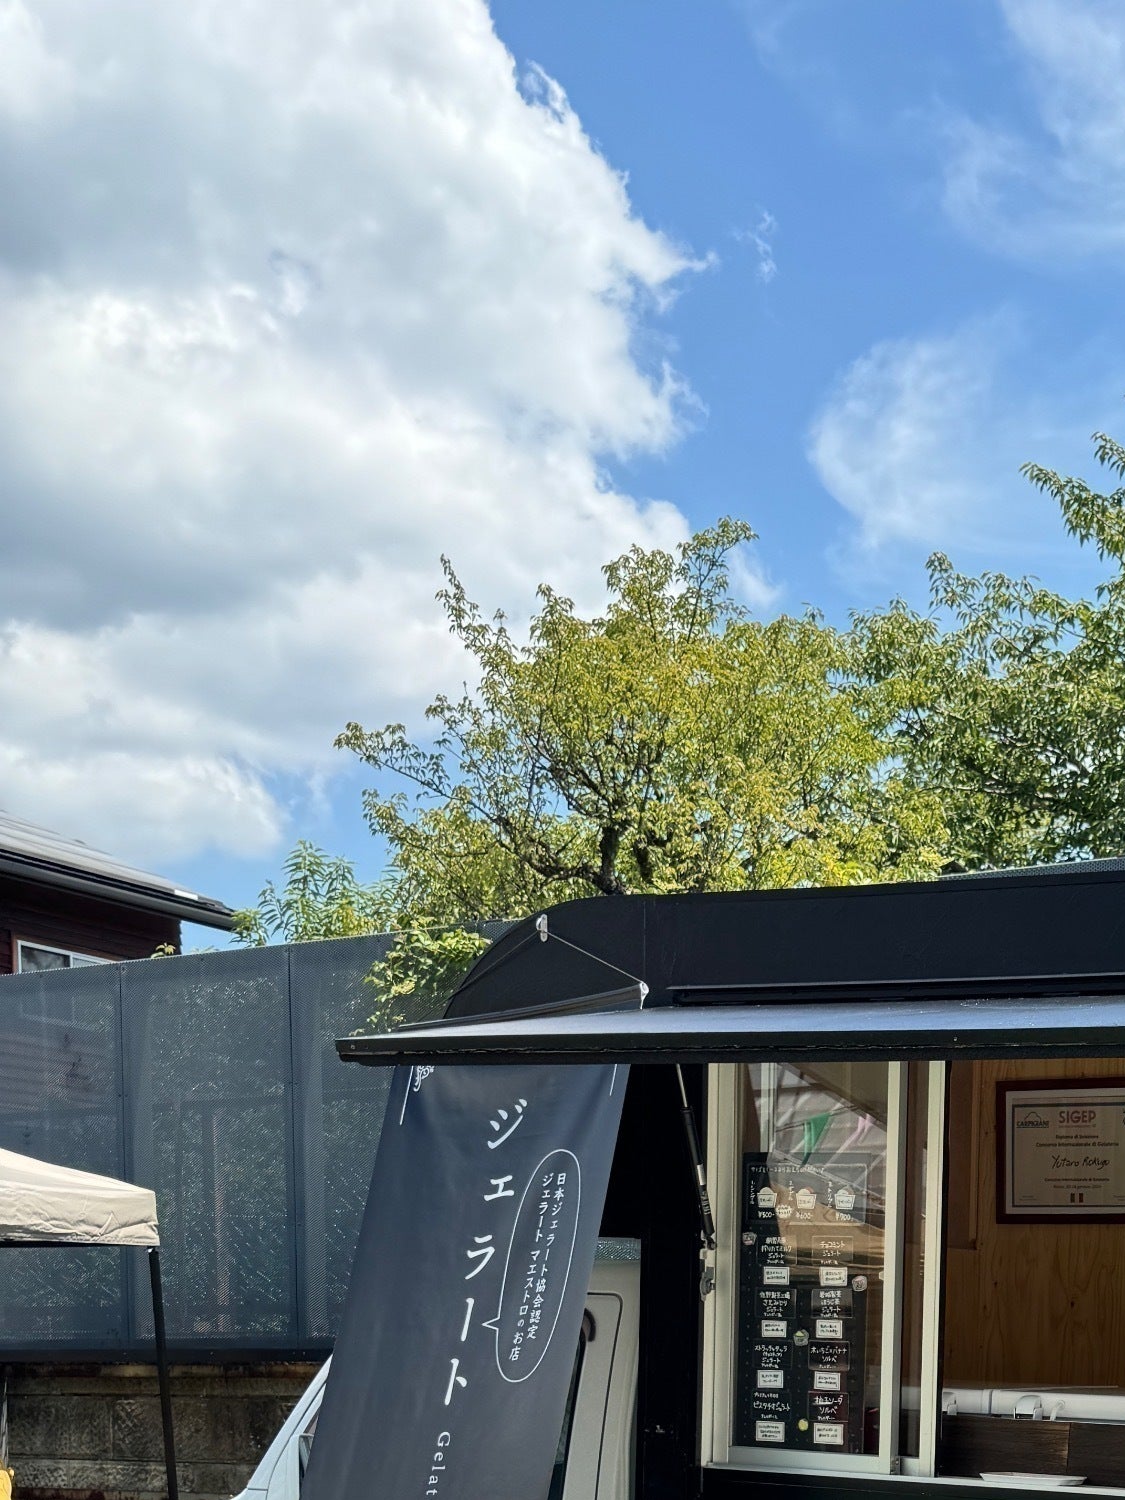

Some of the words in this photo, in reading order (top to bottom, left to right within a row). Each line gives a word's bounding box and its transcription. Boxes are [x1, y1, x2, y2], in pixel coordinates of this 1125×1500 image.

[1051, 1154, 1080, 1169] Yutaro
[1058, 1110, 1097, 1124] SIGEP
[444, 1098, 528, 1406] ジェラート
[526, 1173, 567, 1340] 日本ジェラート協会認定
